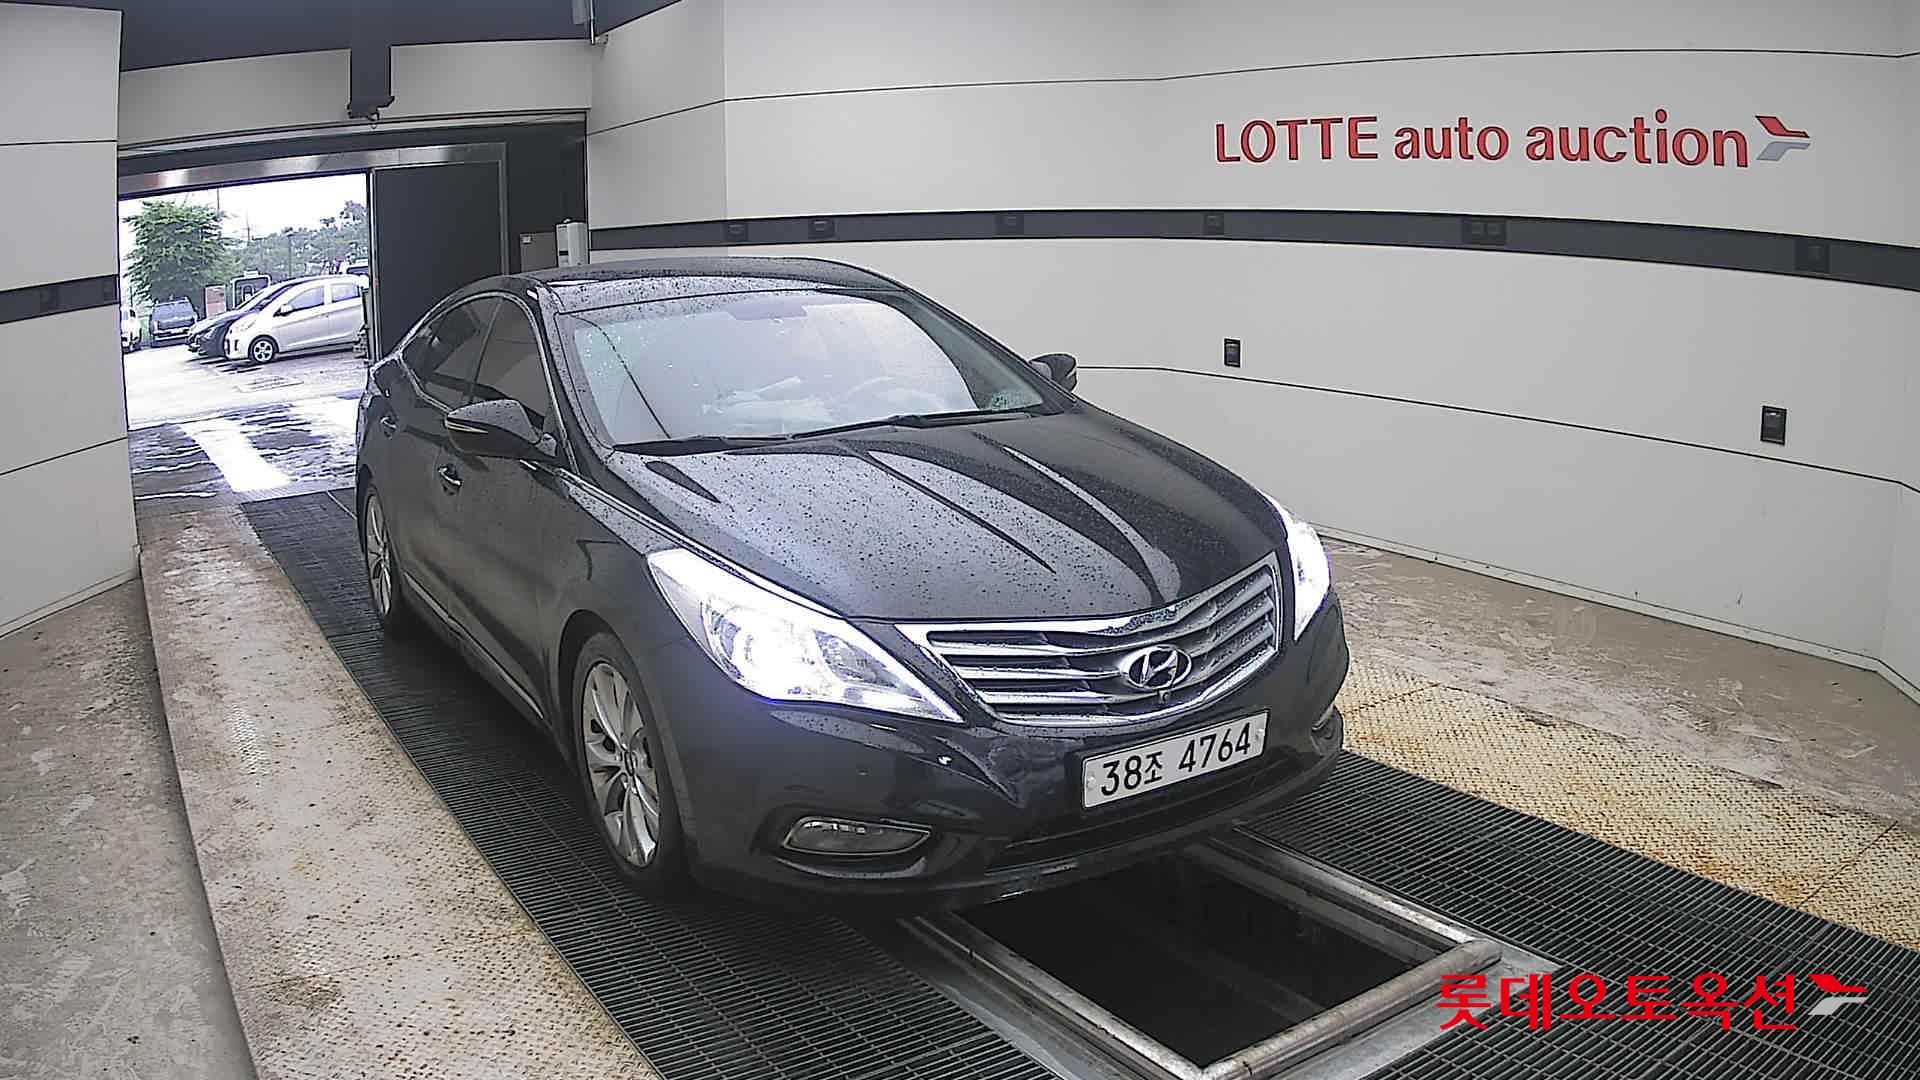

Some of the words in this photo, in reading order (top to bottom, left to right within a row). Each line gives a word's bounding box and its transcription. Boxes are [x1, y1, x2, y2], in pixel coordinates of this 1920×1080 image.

[1215, 115, 1379, 163] LOTTE
[1394, 116, 1509, 161] auto
[1525, 109, 1750, 168] auction
[1100, 751, 1163, 796] 38조
[1178, 722, 1251, 773] 4764
